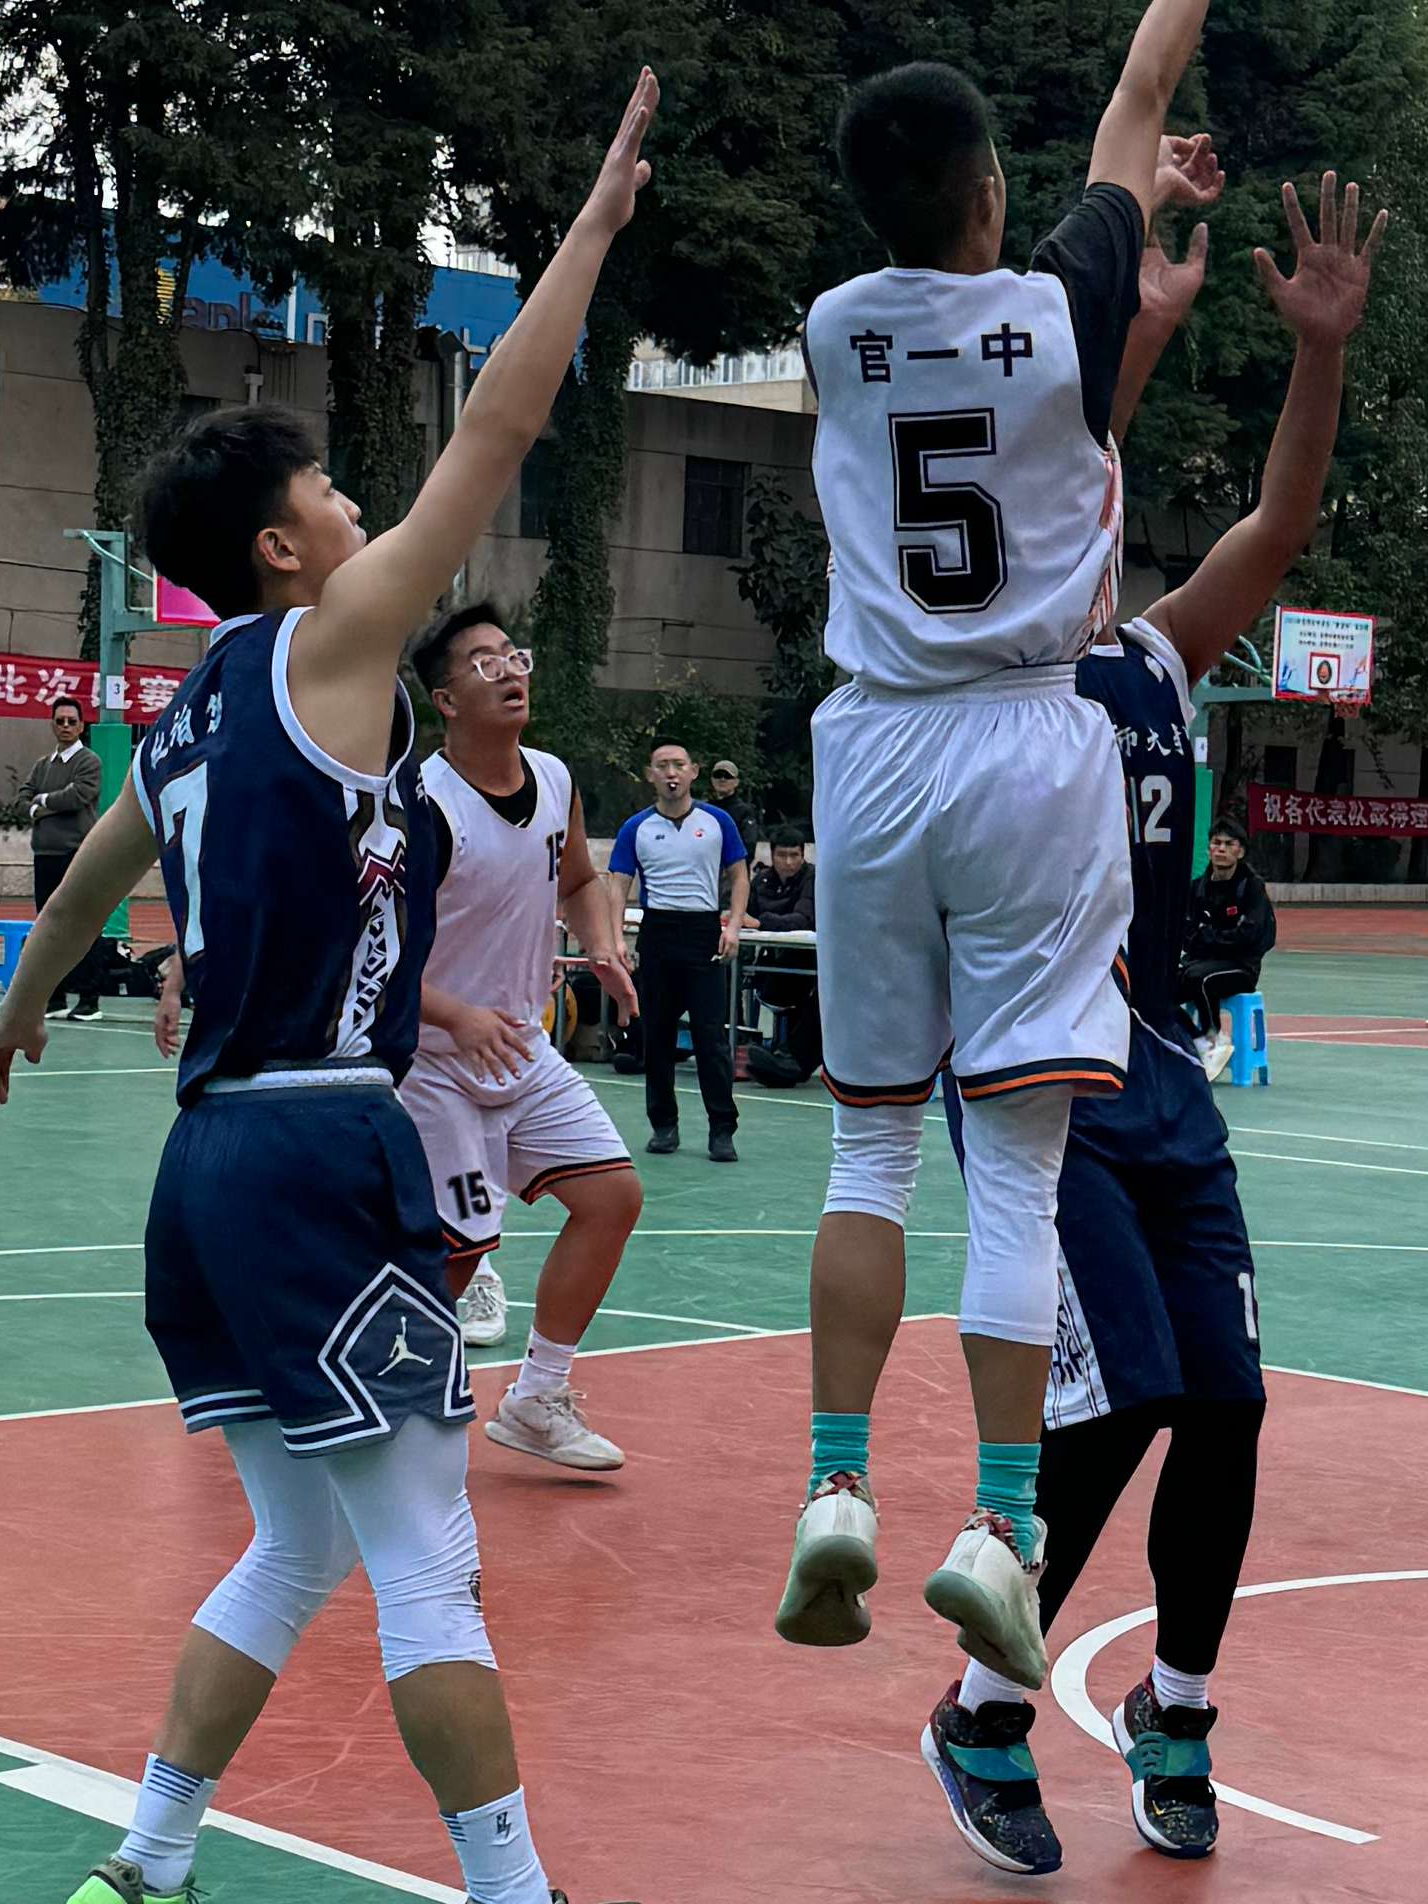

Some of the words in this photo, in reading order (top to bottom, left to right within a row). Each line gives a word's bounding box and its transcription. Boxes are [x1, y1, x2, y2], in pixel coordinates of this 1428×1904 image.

[849, 323, 1033, 383] 官一中
[888, 407, 1008, 615] 5
[113, 683, 121, 695] 3
[1130, 775, 1173, 843] 12
[159, 761, 208, 959] 7
[446, 1170, 492, 1220] 15
